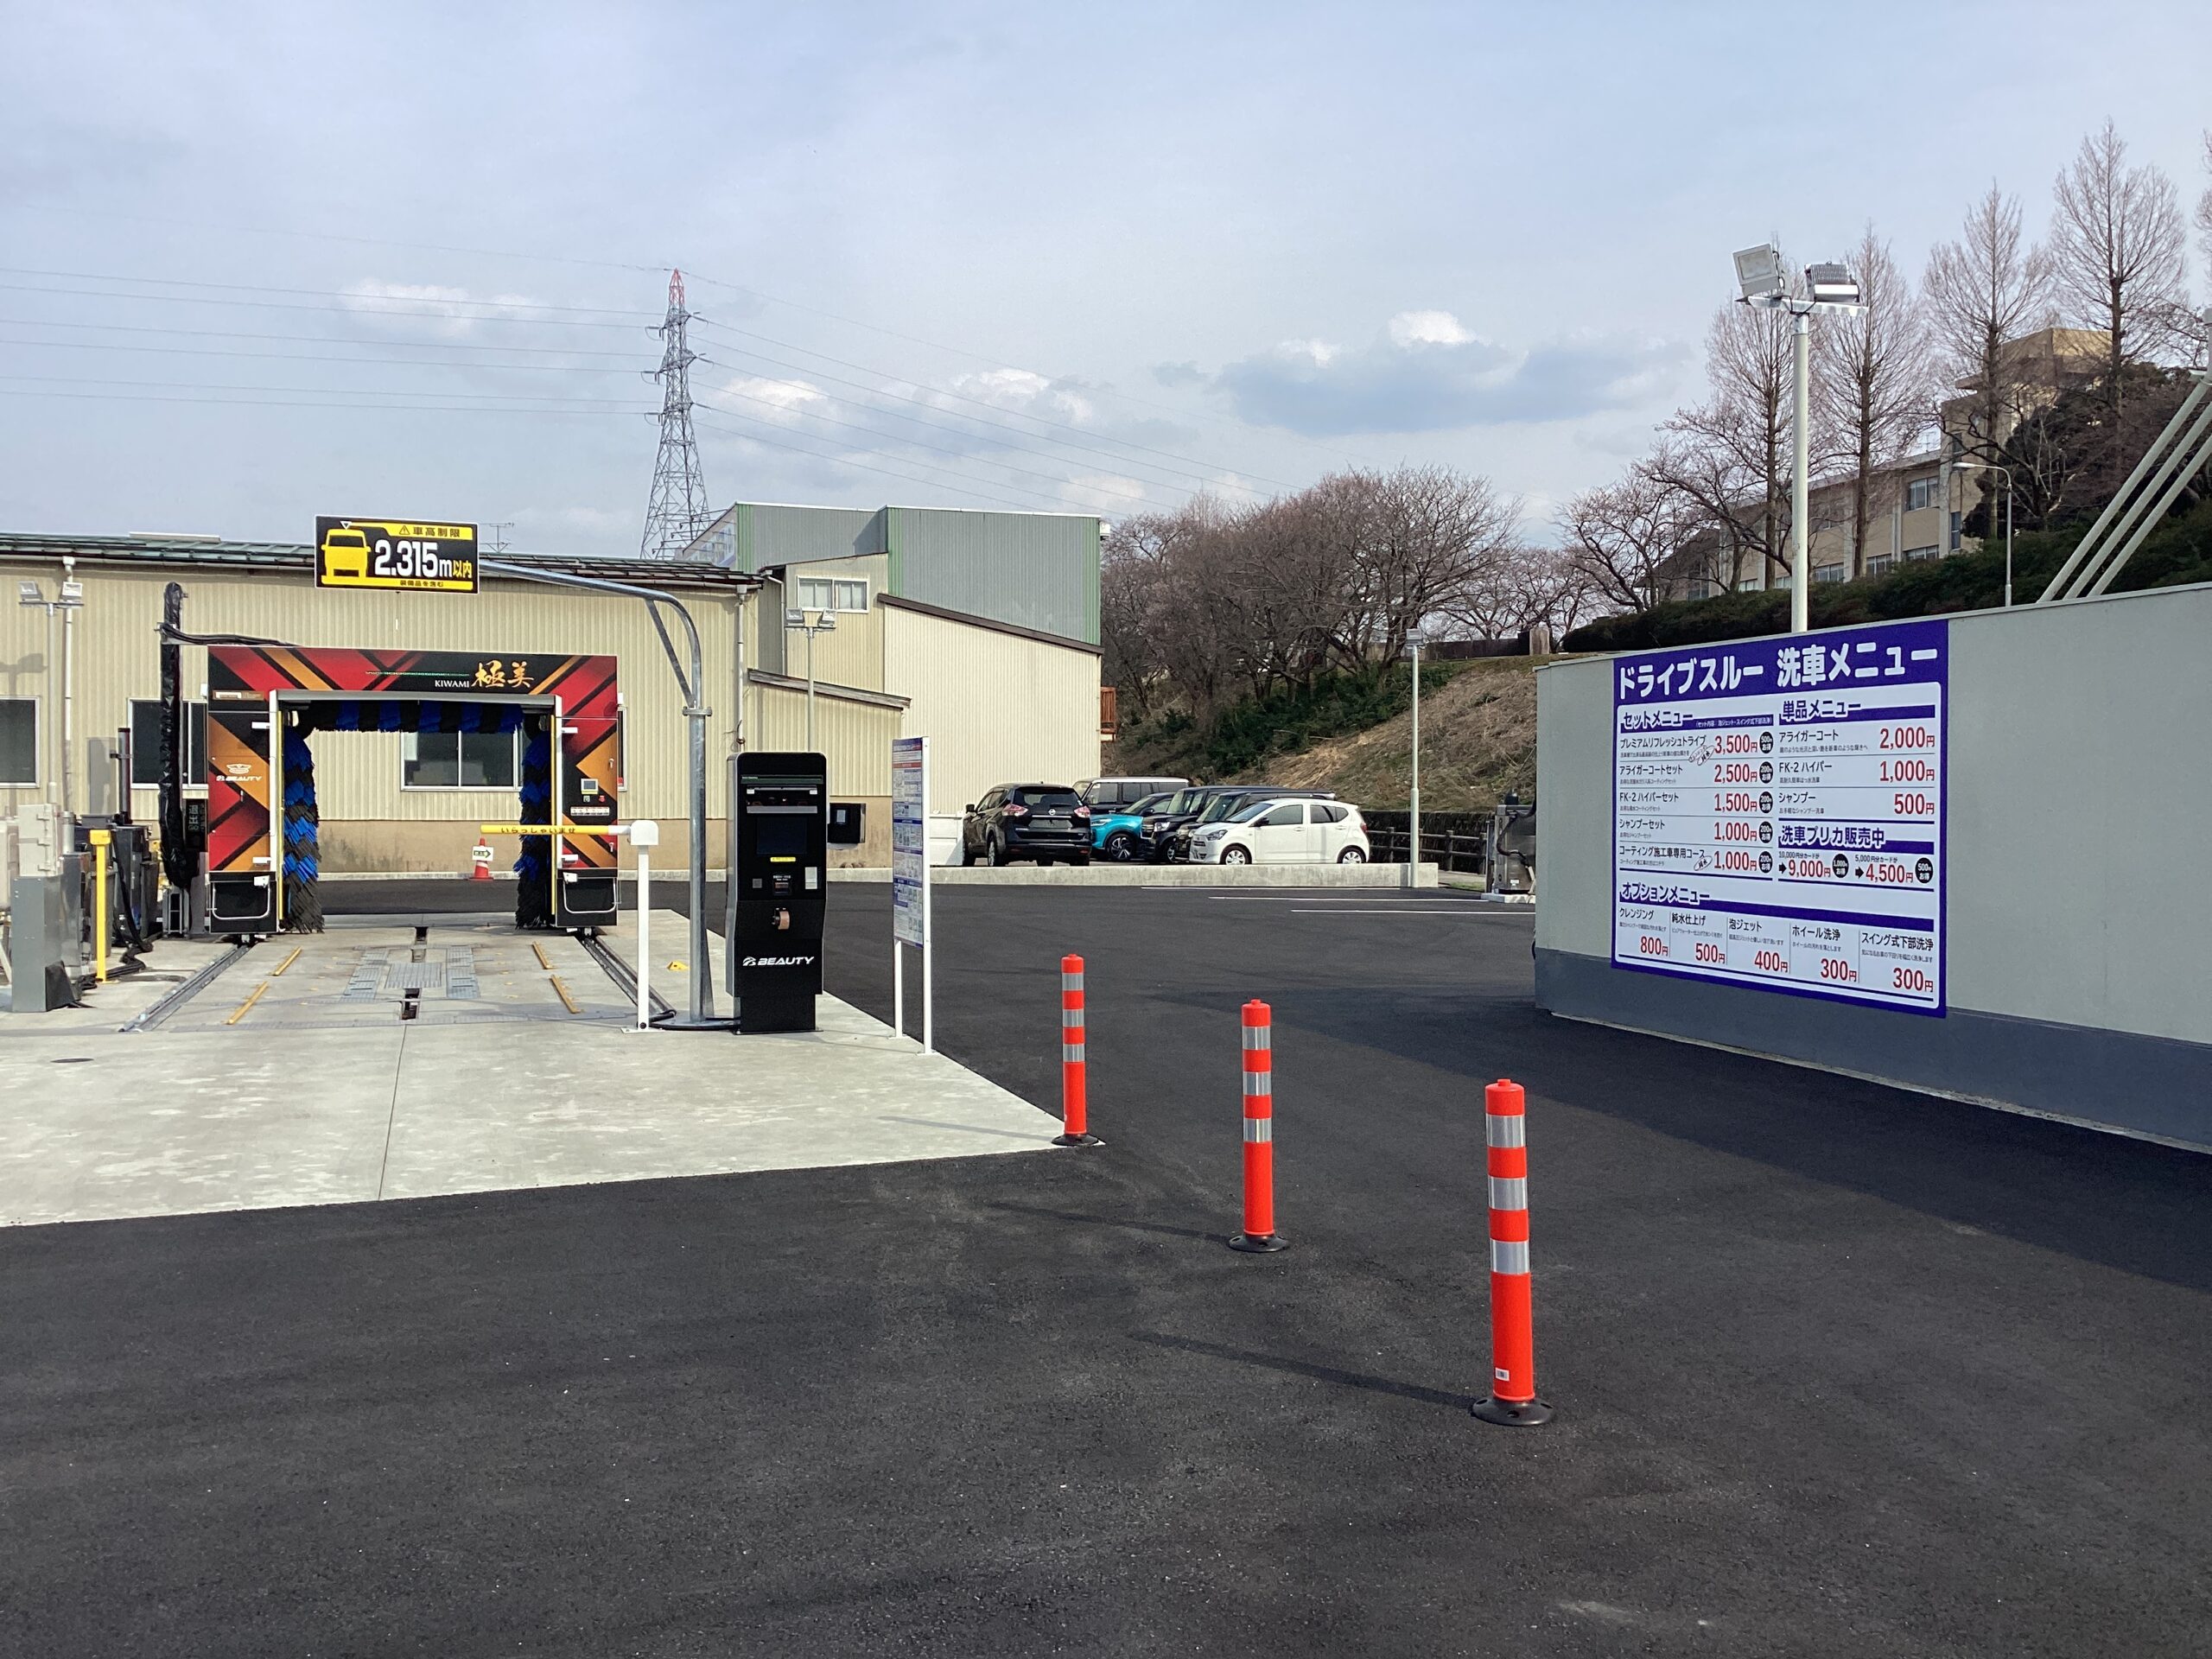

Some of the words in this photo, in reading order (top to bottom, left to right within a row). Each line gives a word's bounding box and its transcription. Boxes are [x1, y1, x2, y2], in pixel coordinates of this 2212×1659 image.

[413, 526, 461, 537] 車高制限
[1620, 656, 1764, 699] ドライブスルー
[1777, 642, 1938, 688] 洗車メニュー
[435, 679, 470, 689] KIWAMI
[1623, 710, 1694, 728] セットメニュー
[1783, 699, 1861, 720] 単品メニュー
[1714, 734, 1758, 755] 3,500円
[1779, 729, 1839, 743] アライガーコート
[1879, 727, 1936, 750] 2,000円
[1619, 765, 1683, 776] アライガーコートセット
[1713, 764, 1758, 785] 2,500円
[1801, 760, 1833, 773] ハイパー
[1879, 760, 1935, 782] 1,000円
[1638, 791, 1679, 803] ハイパーセット
[1713, 793, 1758, 812] 1,500円
[1778, 791, 1816, 804] シャンプー
[1894, 793, 1935, 815] 500円
[1619, 818, 1666, 830] シャンプーセット
[1713, 822, 1758, 842] 1,000円
[1782, 825, 1885, 848] 洗車プリカ販売中
[1713, 850, 1758, 872] 1,000円
[1789, 860, 1831, 878] 9,000円
[1866, 863, 1914, 884] 4,500円
[1621, 881, 1710, 903] オプションメニュー
[1619, 907, 1655, 920] クレンジング
[1672, 912, 1707, 926] 純水仕上げ
[1729, 918, 1763, 932] 泡ジェット
[1792, 925, 1841, 942] ホイール洗浄
[1640, 936, 1669, 957] 800円
[1861, 931, 1935, 952] スイング式下部洗浄
[757, 956, 815, 966] BEAUTY
[1695, 943, 1726, 964] 500円
[1754, 950, 1789, 973] 400円
[1821, 957, 1857, 982] 300円
[1892, 967, 1934, 993] 300円
